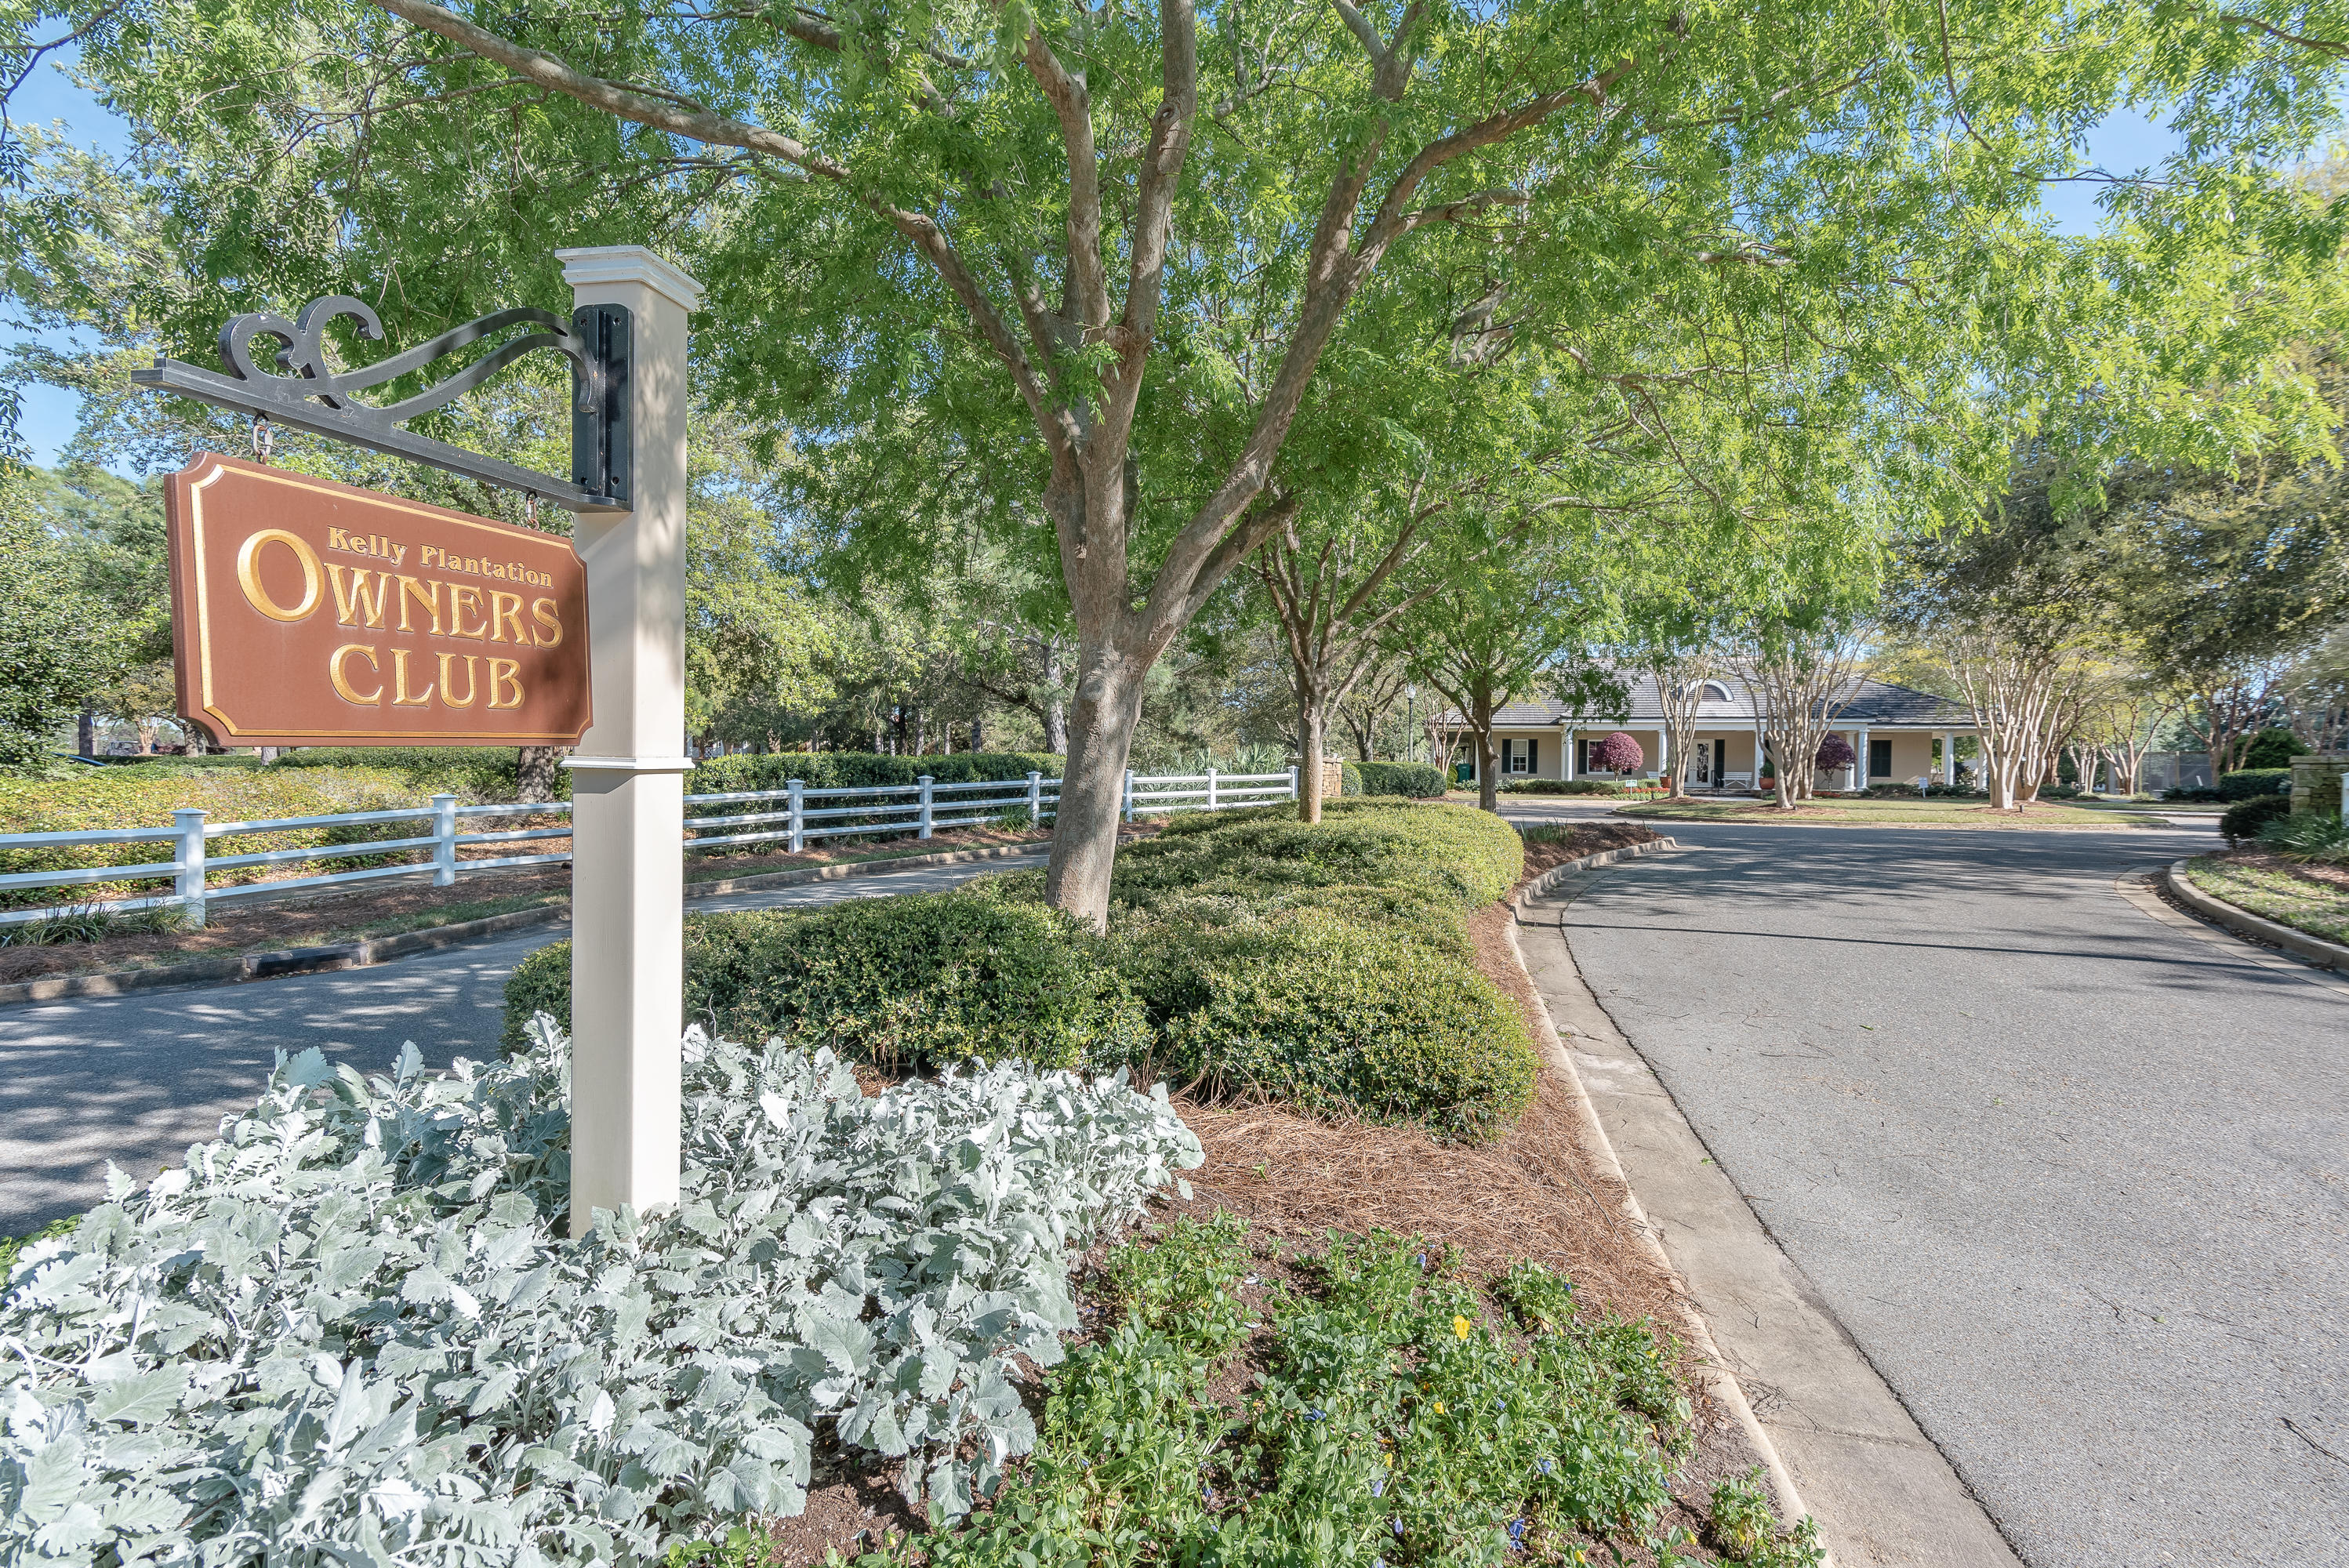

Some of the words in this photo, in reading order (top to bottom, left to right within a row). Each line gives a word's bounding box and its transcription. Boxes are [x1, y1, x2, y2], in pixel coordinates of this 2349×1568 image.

[237, 528, 564, 649] OWNERS
[327, 525, 407, 565] Kelly
[420, 544, 554, 588] Plantation
[329, 644, 525, 710] CLUB
